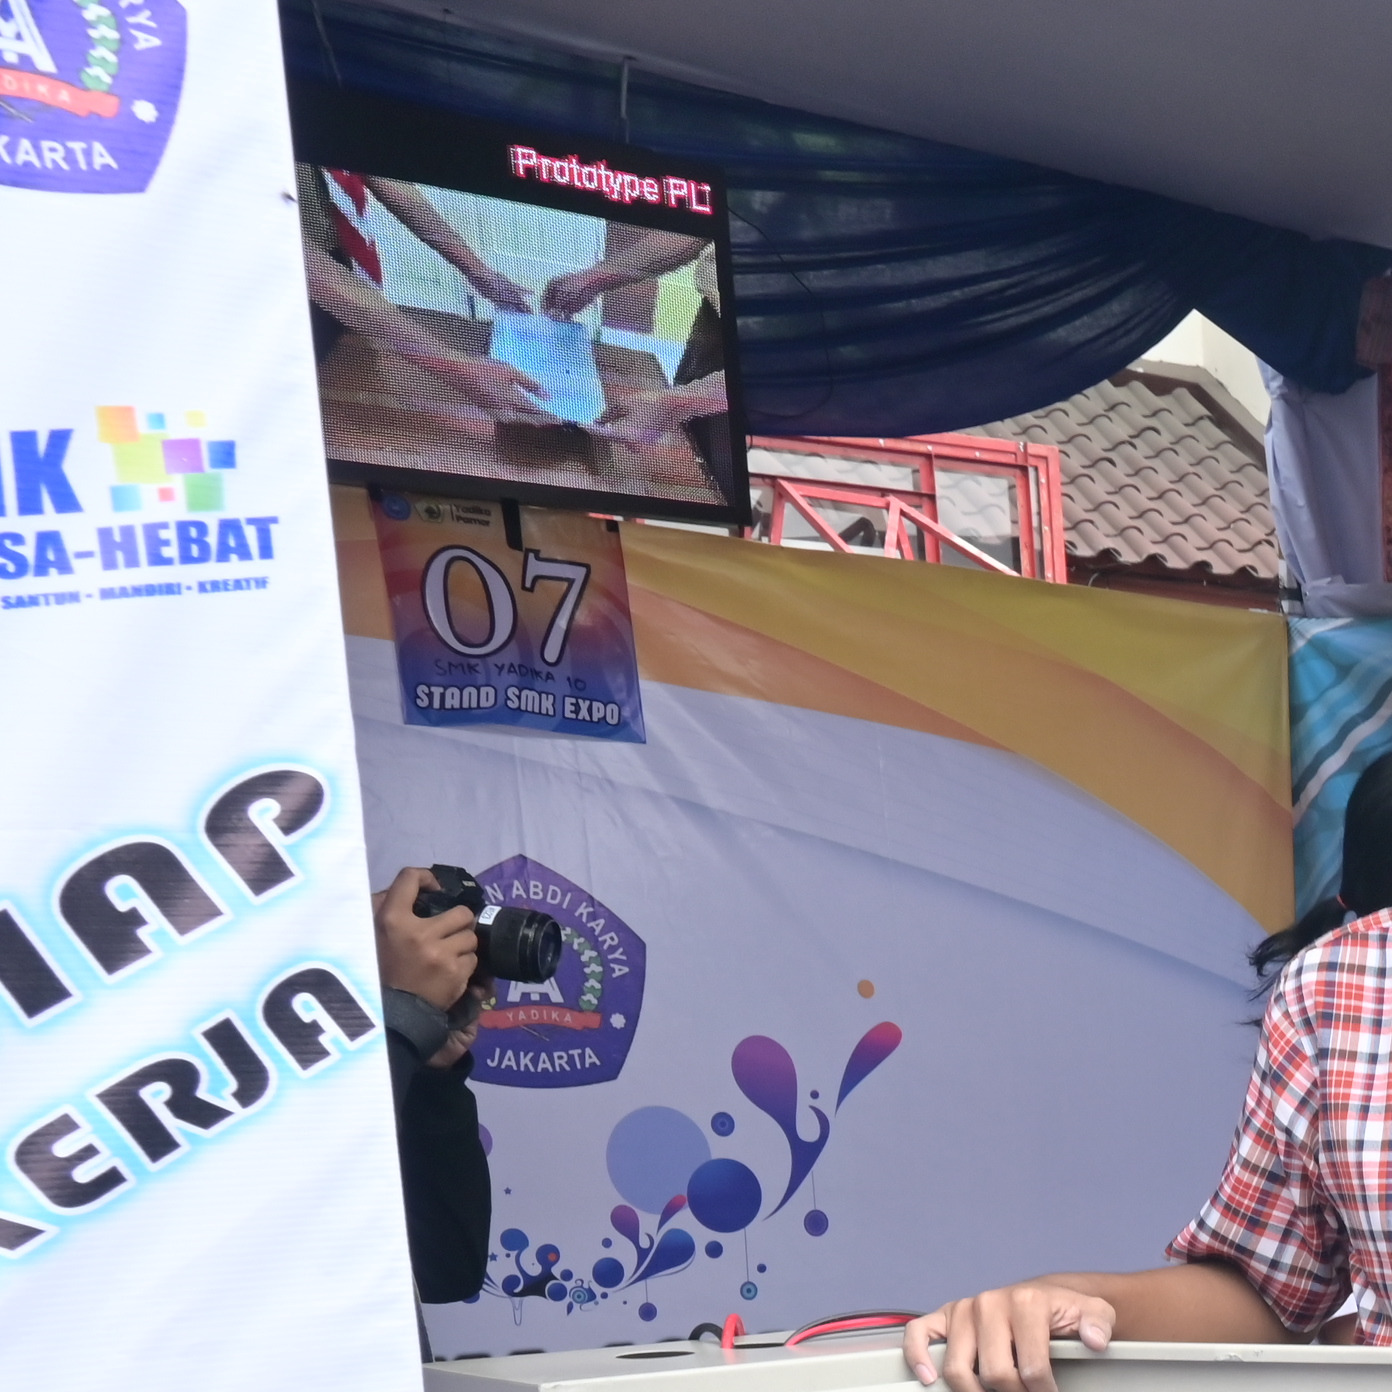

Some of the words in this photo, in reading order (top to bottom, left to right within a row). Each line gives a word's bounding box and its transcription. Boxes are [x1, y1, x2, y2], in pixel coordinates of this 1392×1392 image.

[508, 145, 661, 204] Prototype
[197, 576, 269, 594] KREATIF
[421, 544, 591, 667] 07
[435, 659, 482, 677] SMK
[494, 662, 555, 683] YADIKA
[415, 684, 497, 710] STAND
[505, 686, 555, 717] SMK
[562, 696, 621, 726] EXPO
[512, 880, 572, 909] ABDI
[574, 902, 631, 979] KARYA
[506, 1009, 573, 1024] YADIKA
[486, 1047, 602, 1073] JAKARTA
[0, 966, 378, 1256] ERJA
